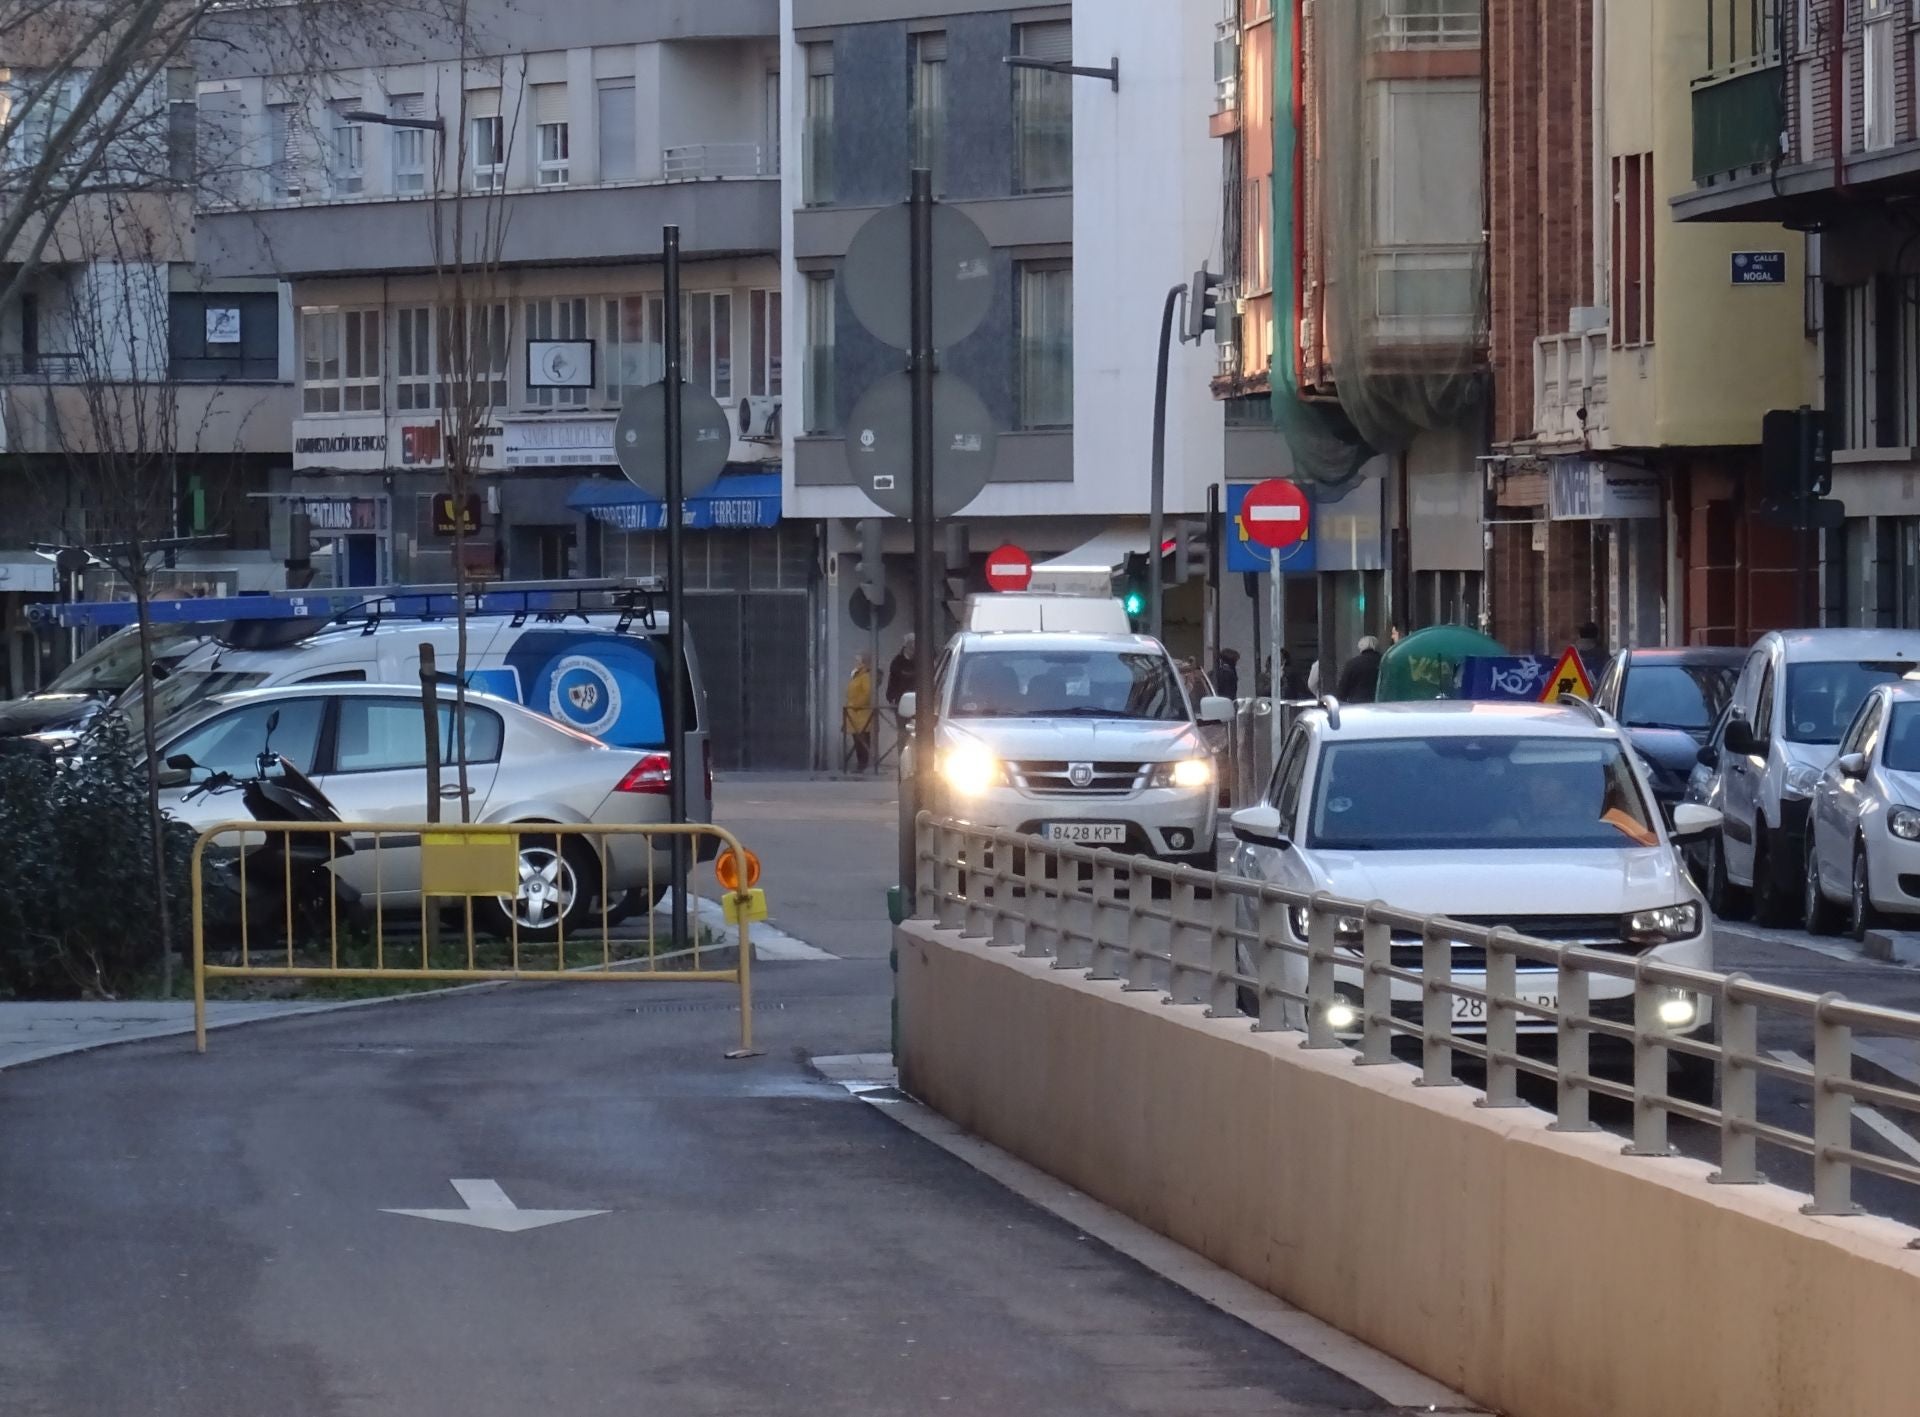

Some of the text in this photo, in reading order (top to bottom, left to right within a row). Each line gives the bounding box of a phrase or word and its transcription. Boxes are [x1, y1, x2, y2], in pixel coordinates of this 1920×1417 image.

[1754, 254, 1778, 262] CALLE
[1743, 272, 1773, 281] NOGAL
[295, 433, 385, 453] ADMINISTRACIÓN DE FINCAS
[710, 500, 762, 525] FERRETERIA
[1053, 826, 1122, 840] 8428 KPT
